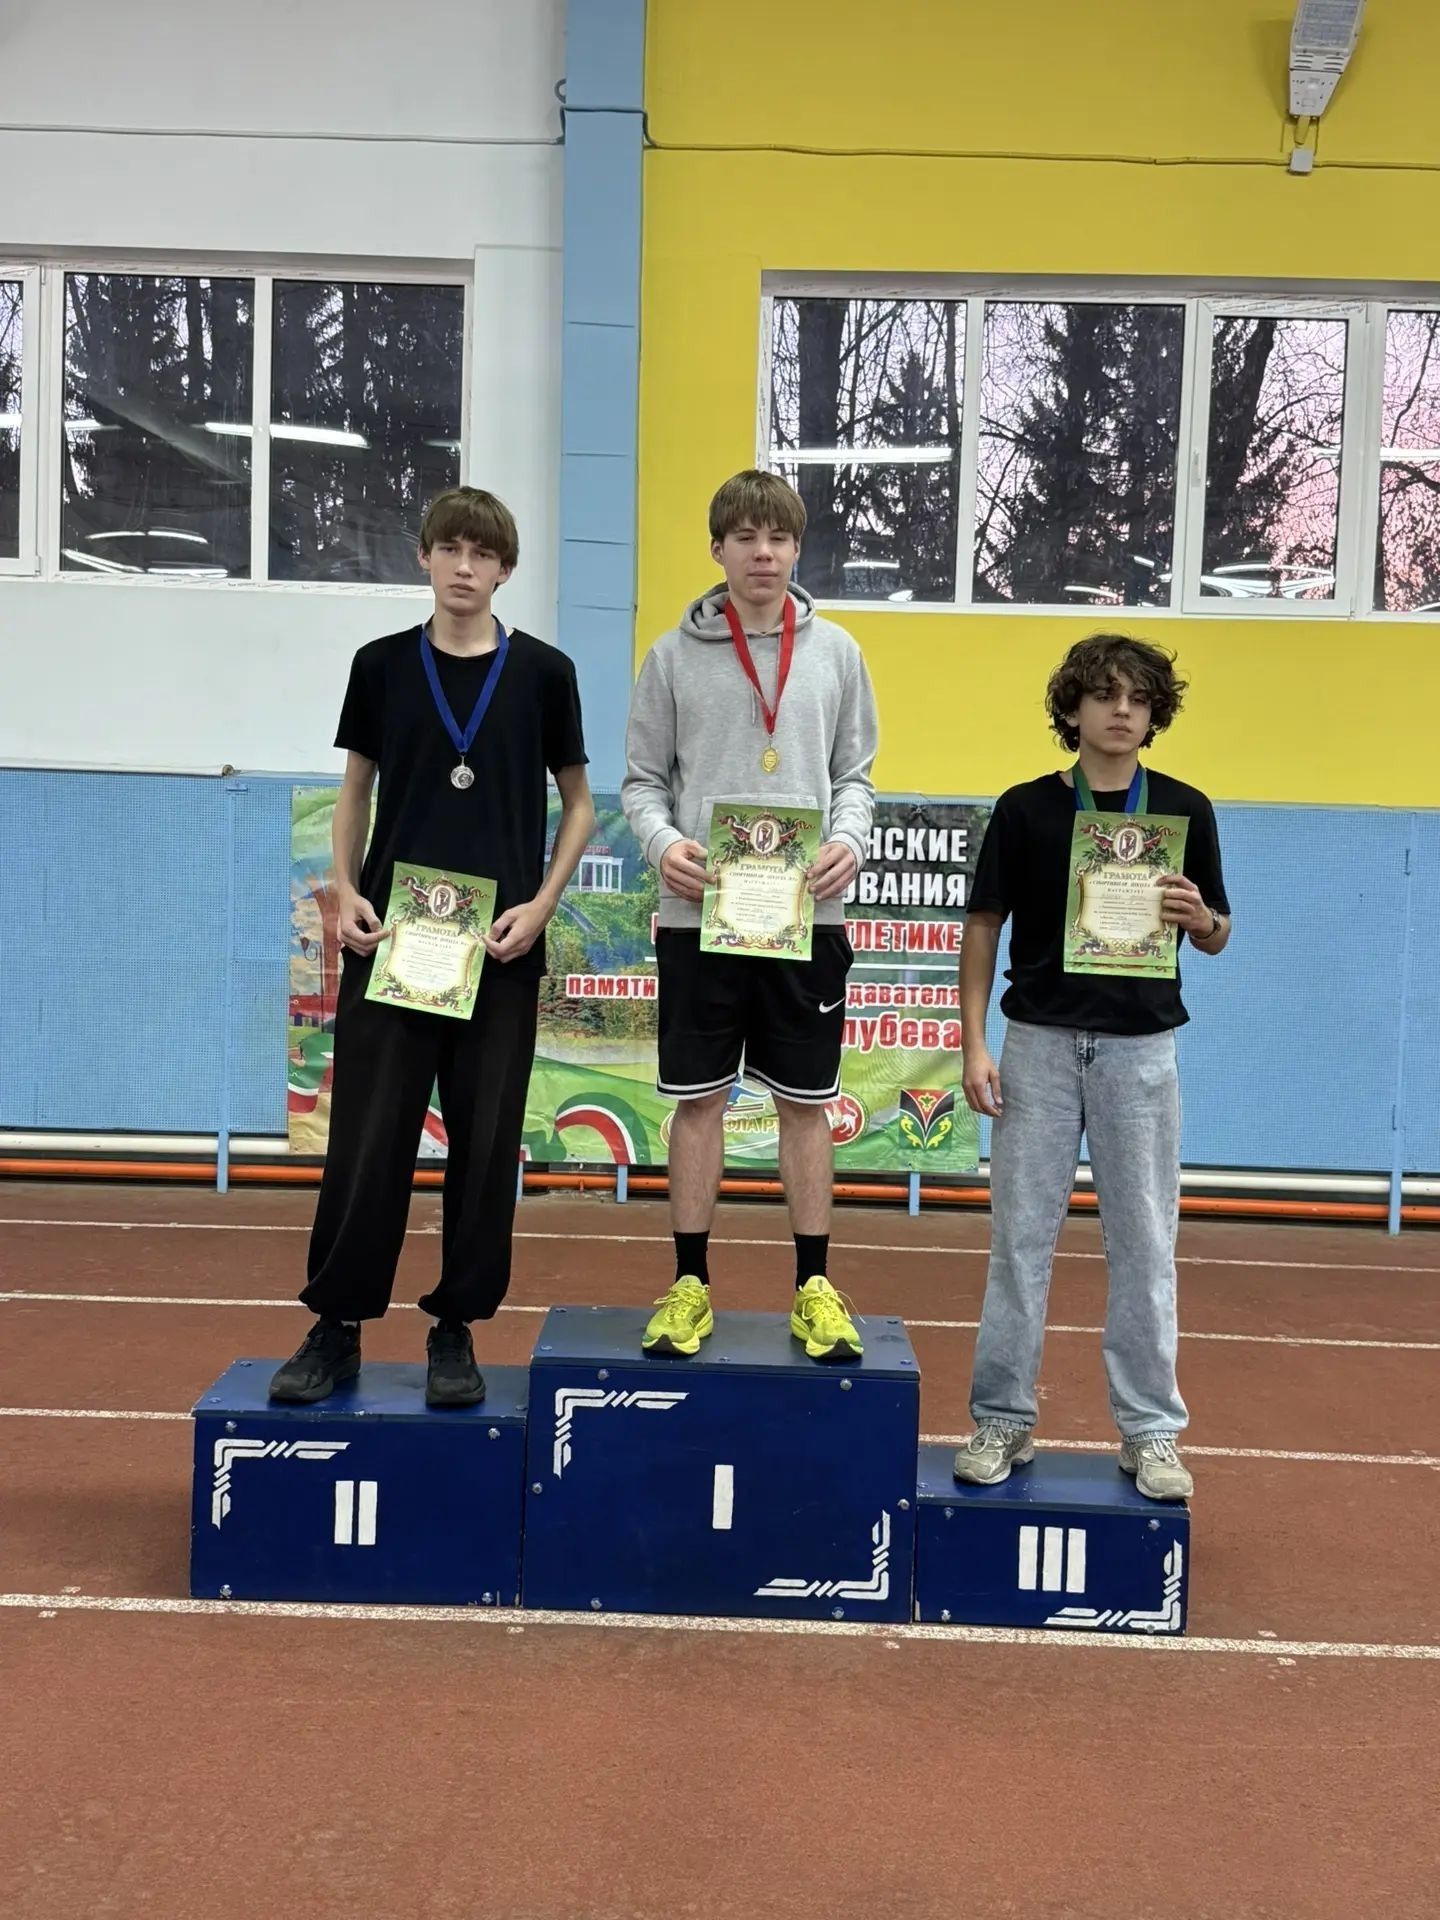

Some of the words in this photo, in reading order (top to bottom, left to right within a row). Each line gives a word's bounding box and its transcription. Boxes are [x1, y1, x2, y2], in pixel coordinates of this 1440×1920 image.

[1103, 871, 1149, 881] ГРАМОТА
[567, 975, 657, 998] памяти
[847, 984, 960, 1007] давателя
[762, 1118, 779, 1134] Р
[334, 1480, 378, 1546] II
[1018, 1525, 1087, 1593] III
